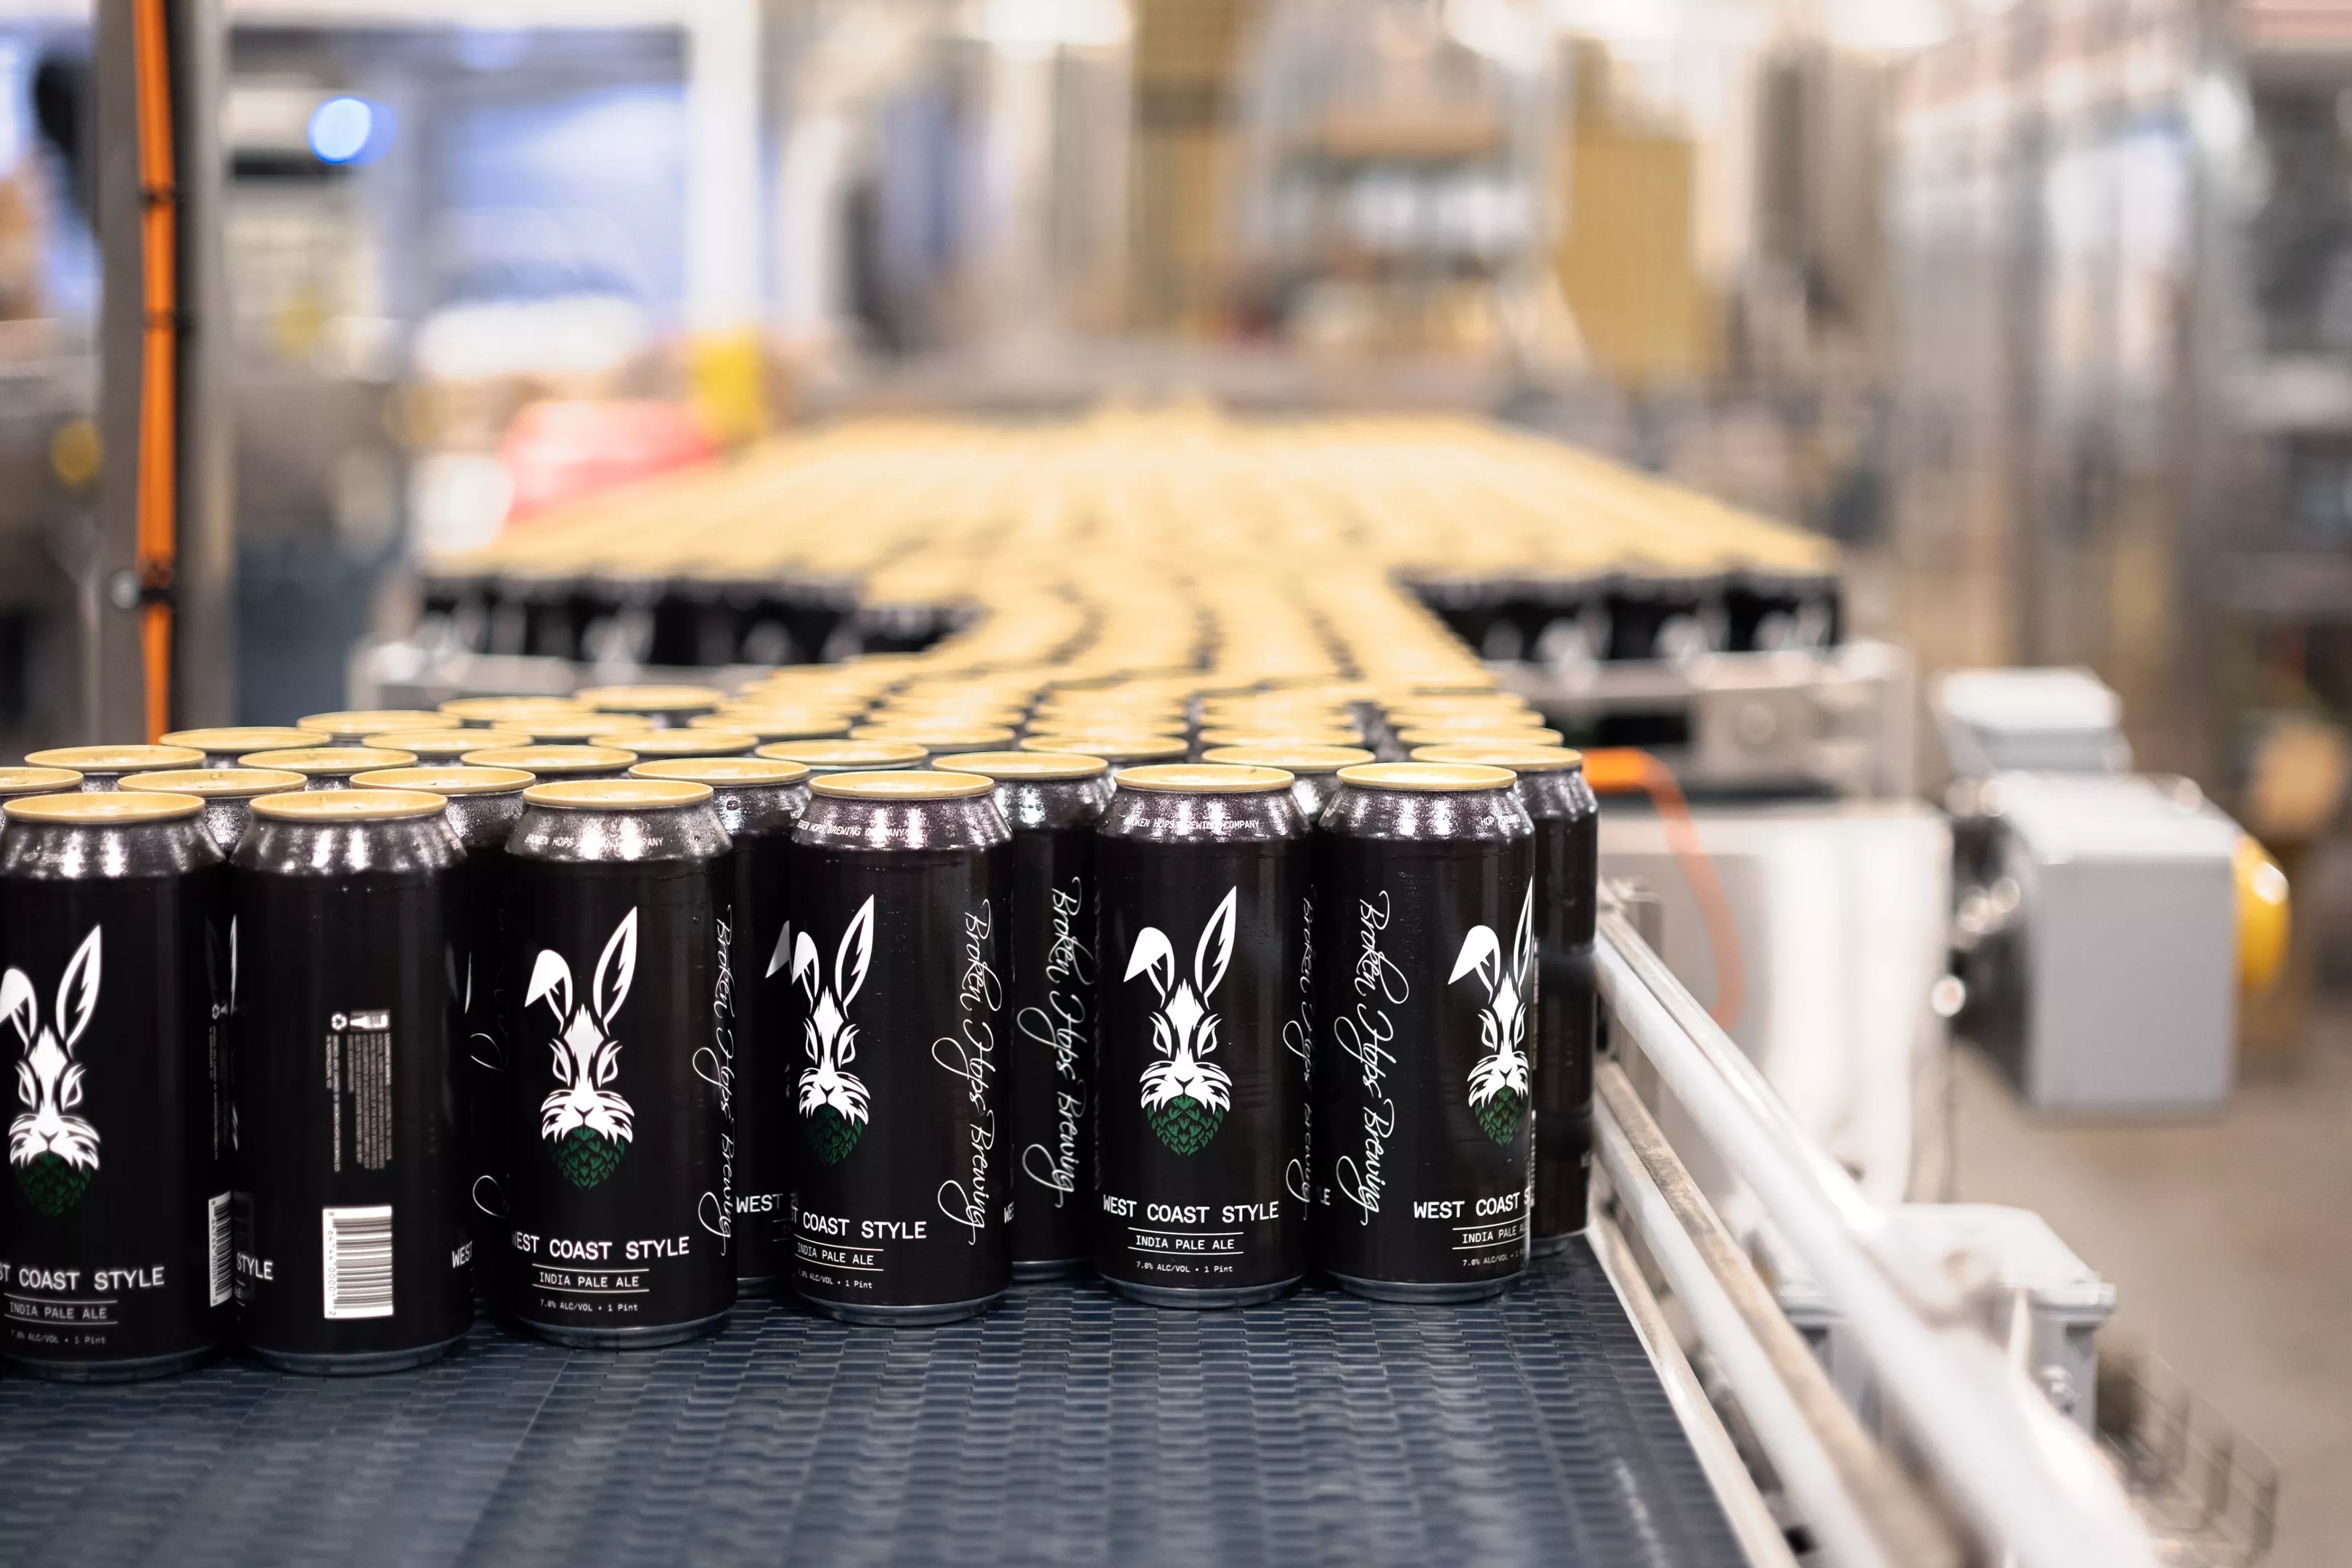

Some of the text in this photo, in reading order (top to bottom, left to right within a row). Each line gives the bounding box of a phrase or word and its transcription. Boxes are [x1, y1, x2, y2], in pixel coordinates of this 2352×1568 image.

[827, 825, 862, 836] BREWING
[865, 828, 905, 837] CANY
[1153, 818, 1175, 829] HOPS
[1223, 820, 1259, 829] COMPANY
[552, 836, 574, 847] HOPS
[959, 899, 1003, 1012] Broken
[1355, 890, 1410, 1005] Broken
[1336, 1098, 1395, 1226] Brewing
[937, 1109, 995, 1246] Brewing
[735, 1193, 783, 1214] WEST
[1103, 1193, 1280, 1224] WEST COAST STYLE
[1413, 1200, 1466, 1219] WEST
[1475, 1191, 1521, 1217] COAST
[802, 1211, 850, 1236] COAST
[861, 1220, 928, 1240] STYLE
[1462, 1230, 1494, 1244] INDIA
[1498, 1225, 1517, 1239] PALE
[512, 1230, 690, 1260] WEST COAST STYLE
[1135, 1234, 1235, 1250] INDIA PALE ALE
[452, 1240, 473, 1269] WEST
[797, 1242, 875, 1265] INDIA PALE ALE
[1483, 1254, 1508, 1265] ALC/VOL
[236, 1252, 274, 1281] STYLE
[1136, 1260, 1153, 1270] 7.0%
[1156, 1263, 1191, 1273] ALC/VOL
[1213, 1265, 1233, 1273] Pint
[19, 1268, 81, 1291] COAST
[94, 1266, 166, 1291] STYLE
[539, 1271, 640, 1288] INDIA PALE ALE
[809, 1273, 834, 1285] ALC/VOL
[854, 1280, 873, 1289] Pint
[9, 1301, 107, 1320] INDIA PALE ALE
[560, 1302, 593, 1312] ALC/VOL
[618, 1303, 639, 1312] Pint
[28, 1333, 60, 1344] ALC/VOL
